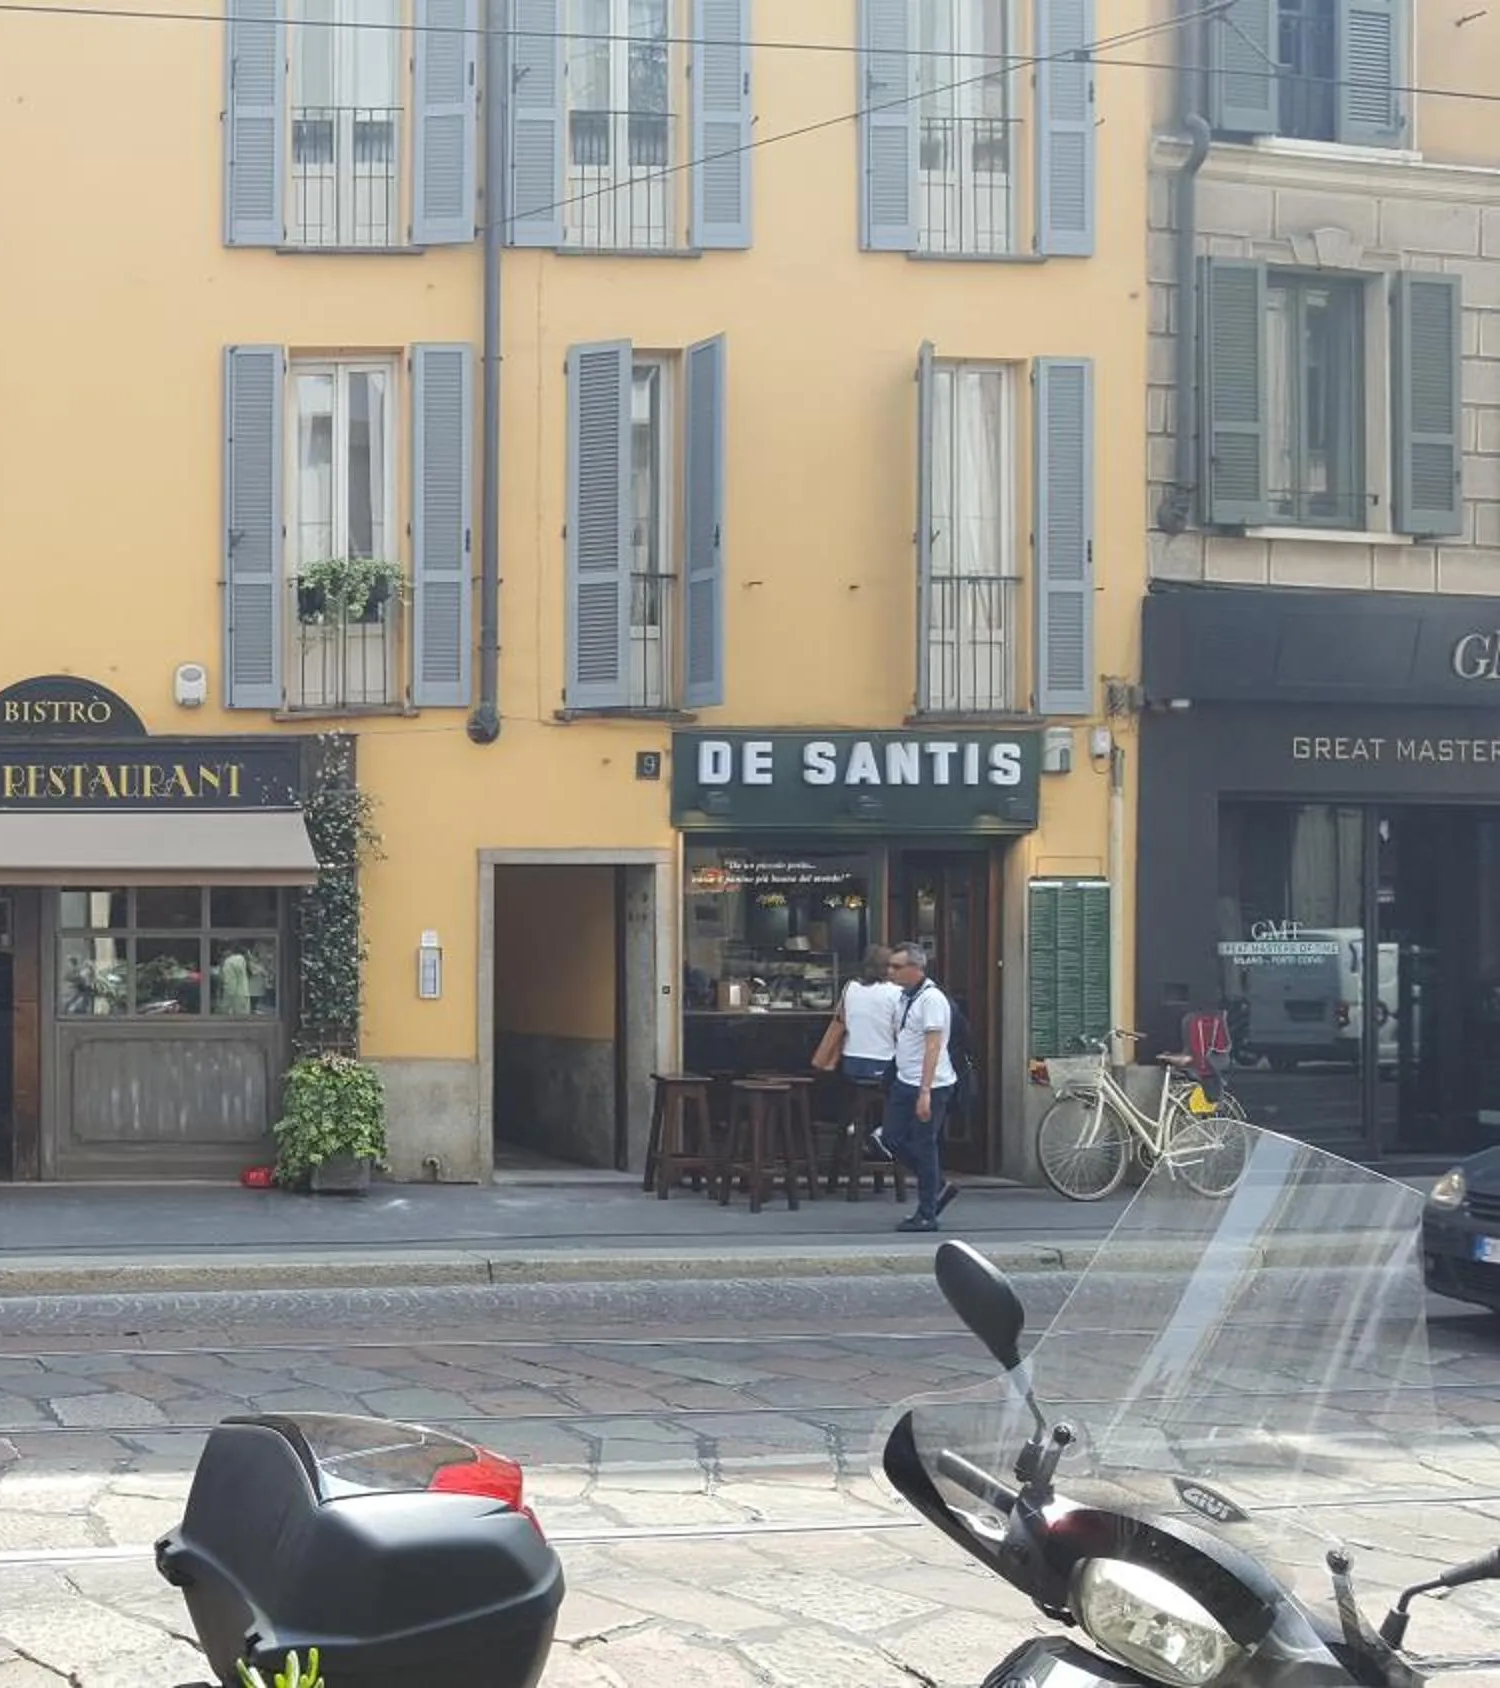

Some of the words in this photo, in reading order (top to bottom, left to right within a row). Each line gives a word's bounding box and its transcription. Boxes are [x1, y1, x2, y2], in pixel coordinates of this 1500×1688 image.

[1454, 629, 1500, 680] G
[3, 696, 112, 724] BISTRÒ
[698, 741, 773, 785] DE
[803, 741, 1021, 786] SANTIS
[1293, 737, 1387, 760] GREAT
[1397, 738, 1500, 763] MASTER
[643, 755, 655, 775] 9
[2, 763, 244, 798] RESTAURANT
[1251, 919, 1304, 941] GMT
